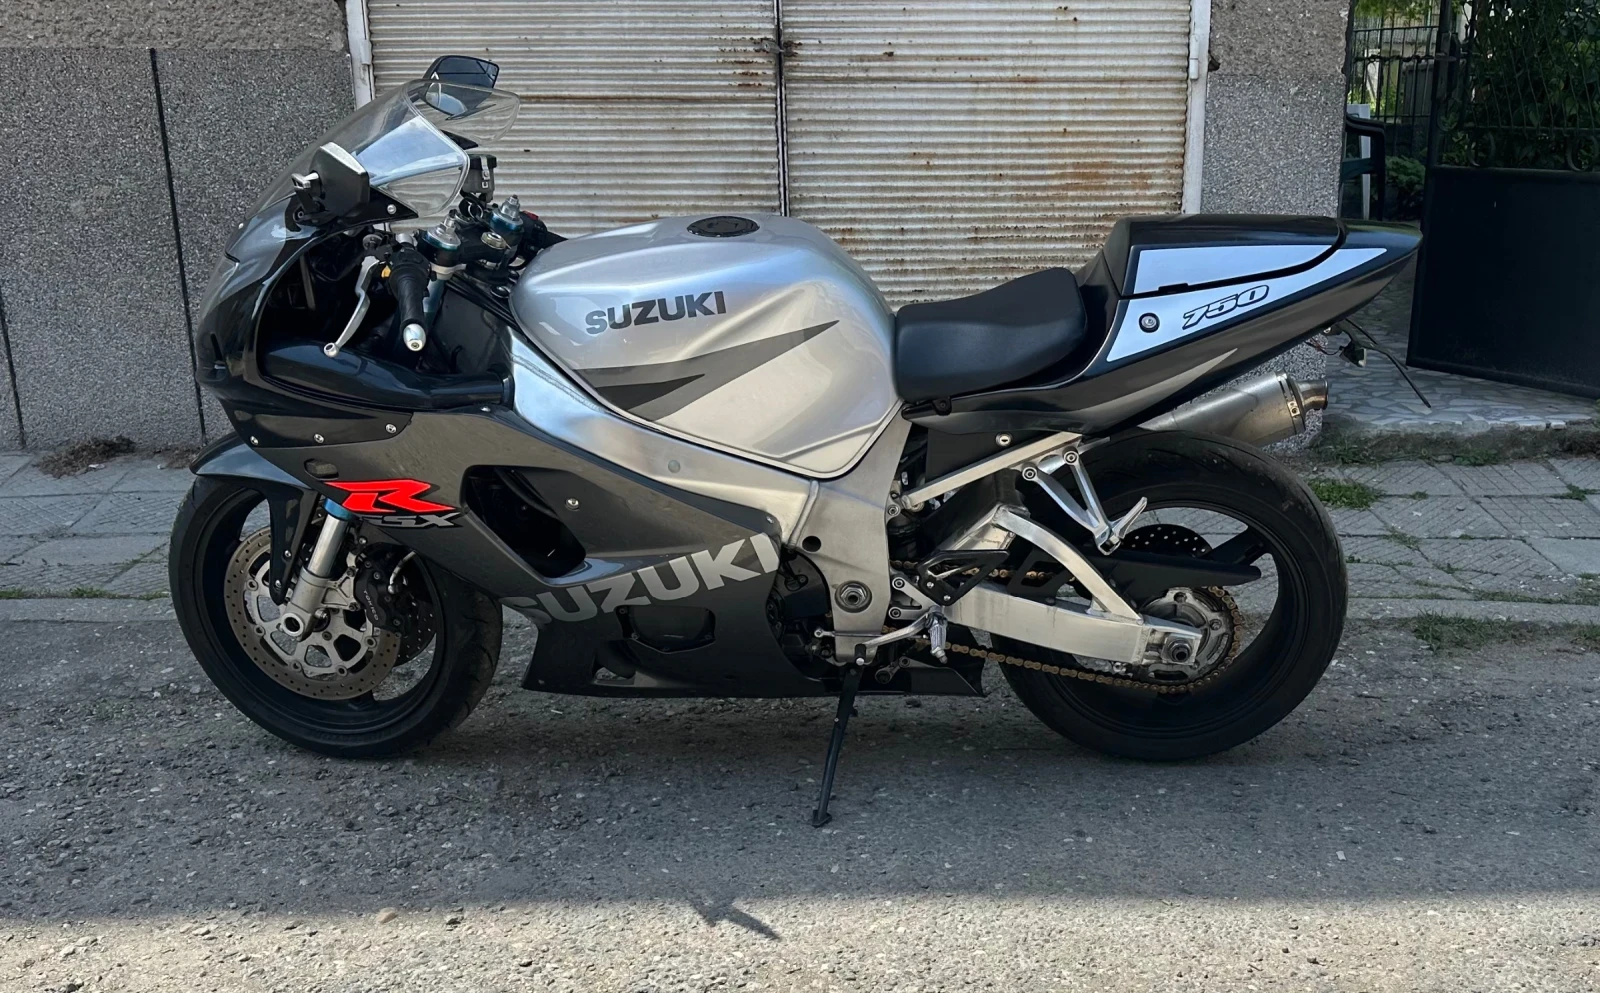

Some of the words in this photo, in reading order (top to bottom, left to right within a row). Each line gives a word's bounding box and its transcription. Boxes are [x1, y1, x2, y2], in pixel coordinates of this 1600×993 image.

[585, 290, 726, 335] SUZUKI
[1182, 284, 1270, 330] 750
[498, 532, 780, 624] SUZUKI
[363, 589, 379, 621] TOKICO
